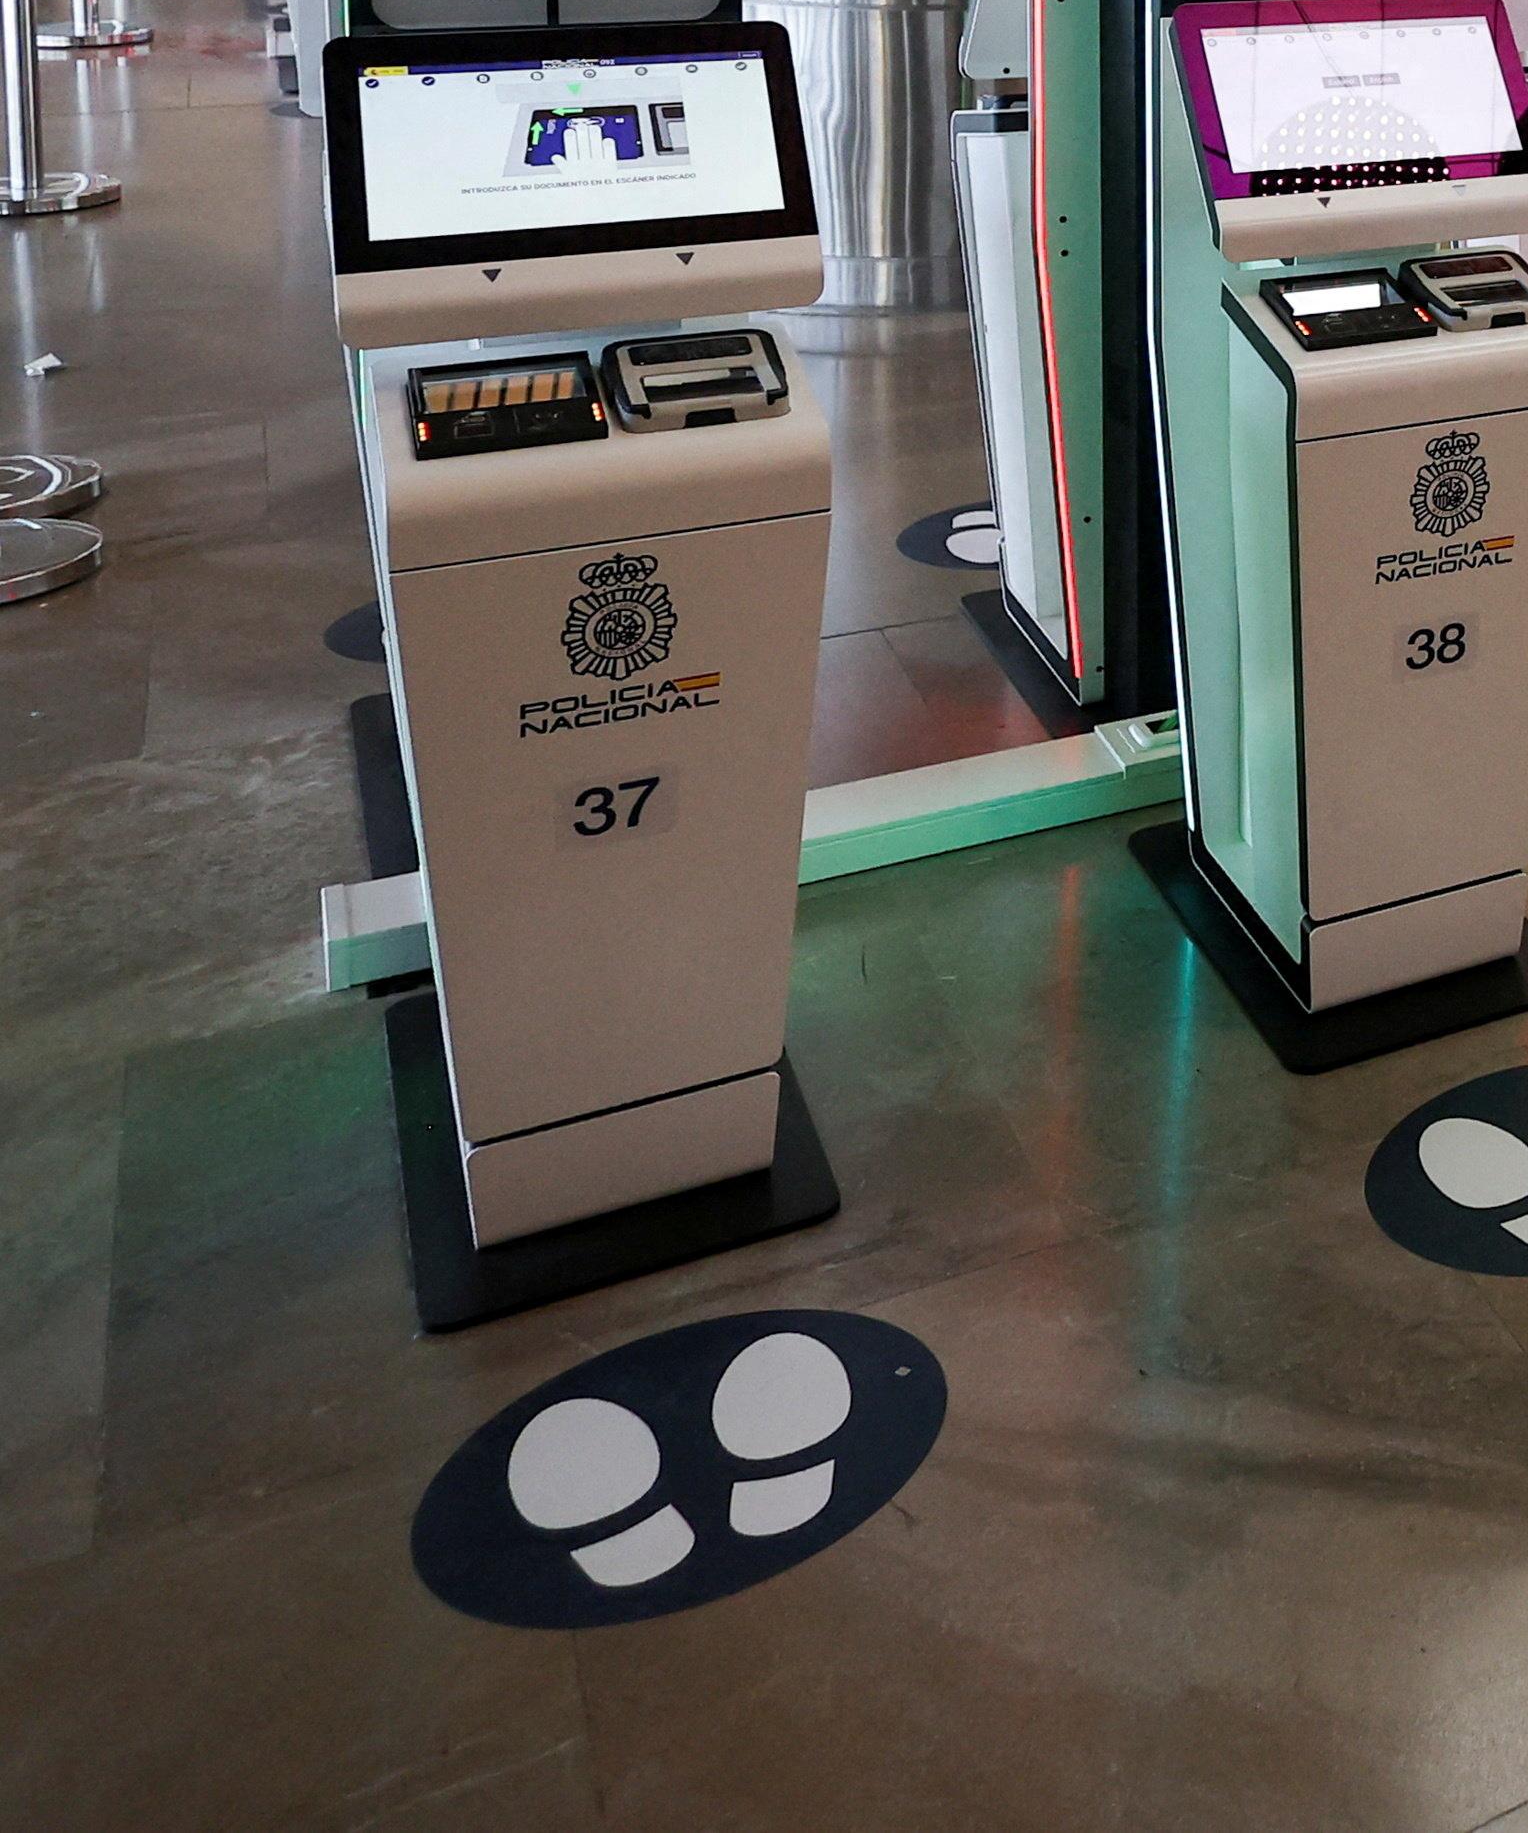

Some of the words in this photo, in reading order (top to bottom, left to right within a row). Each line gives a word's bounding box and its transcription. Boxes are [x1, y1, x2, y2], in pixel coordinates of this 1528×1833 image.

[461, 184, 518, 194] INTRODUZCA
[533, 178, 589, 190] DOCUMENTO
[656, 172, 697, 181] INDICADO
[1375, 552, 1513, 584] NACIONAL
[1376, 540, 1486, 569] POLICIA
[1406, 623, 1466, 670] 38
[519, 680, 679, 720] POLICIA
[520, 693, 720, 738] NACIONAL
[573, 776, 660, 836] 37
